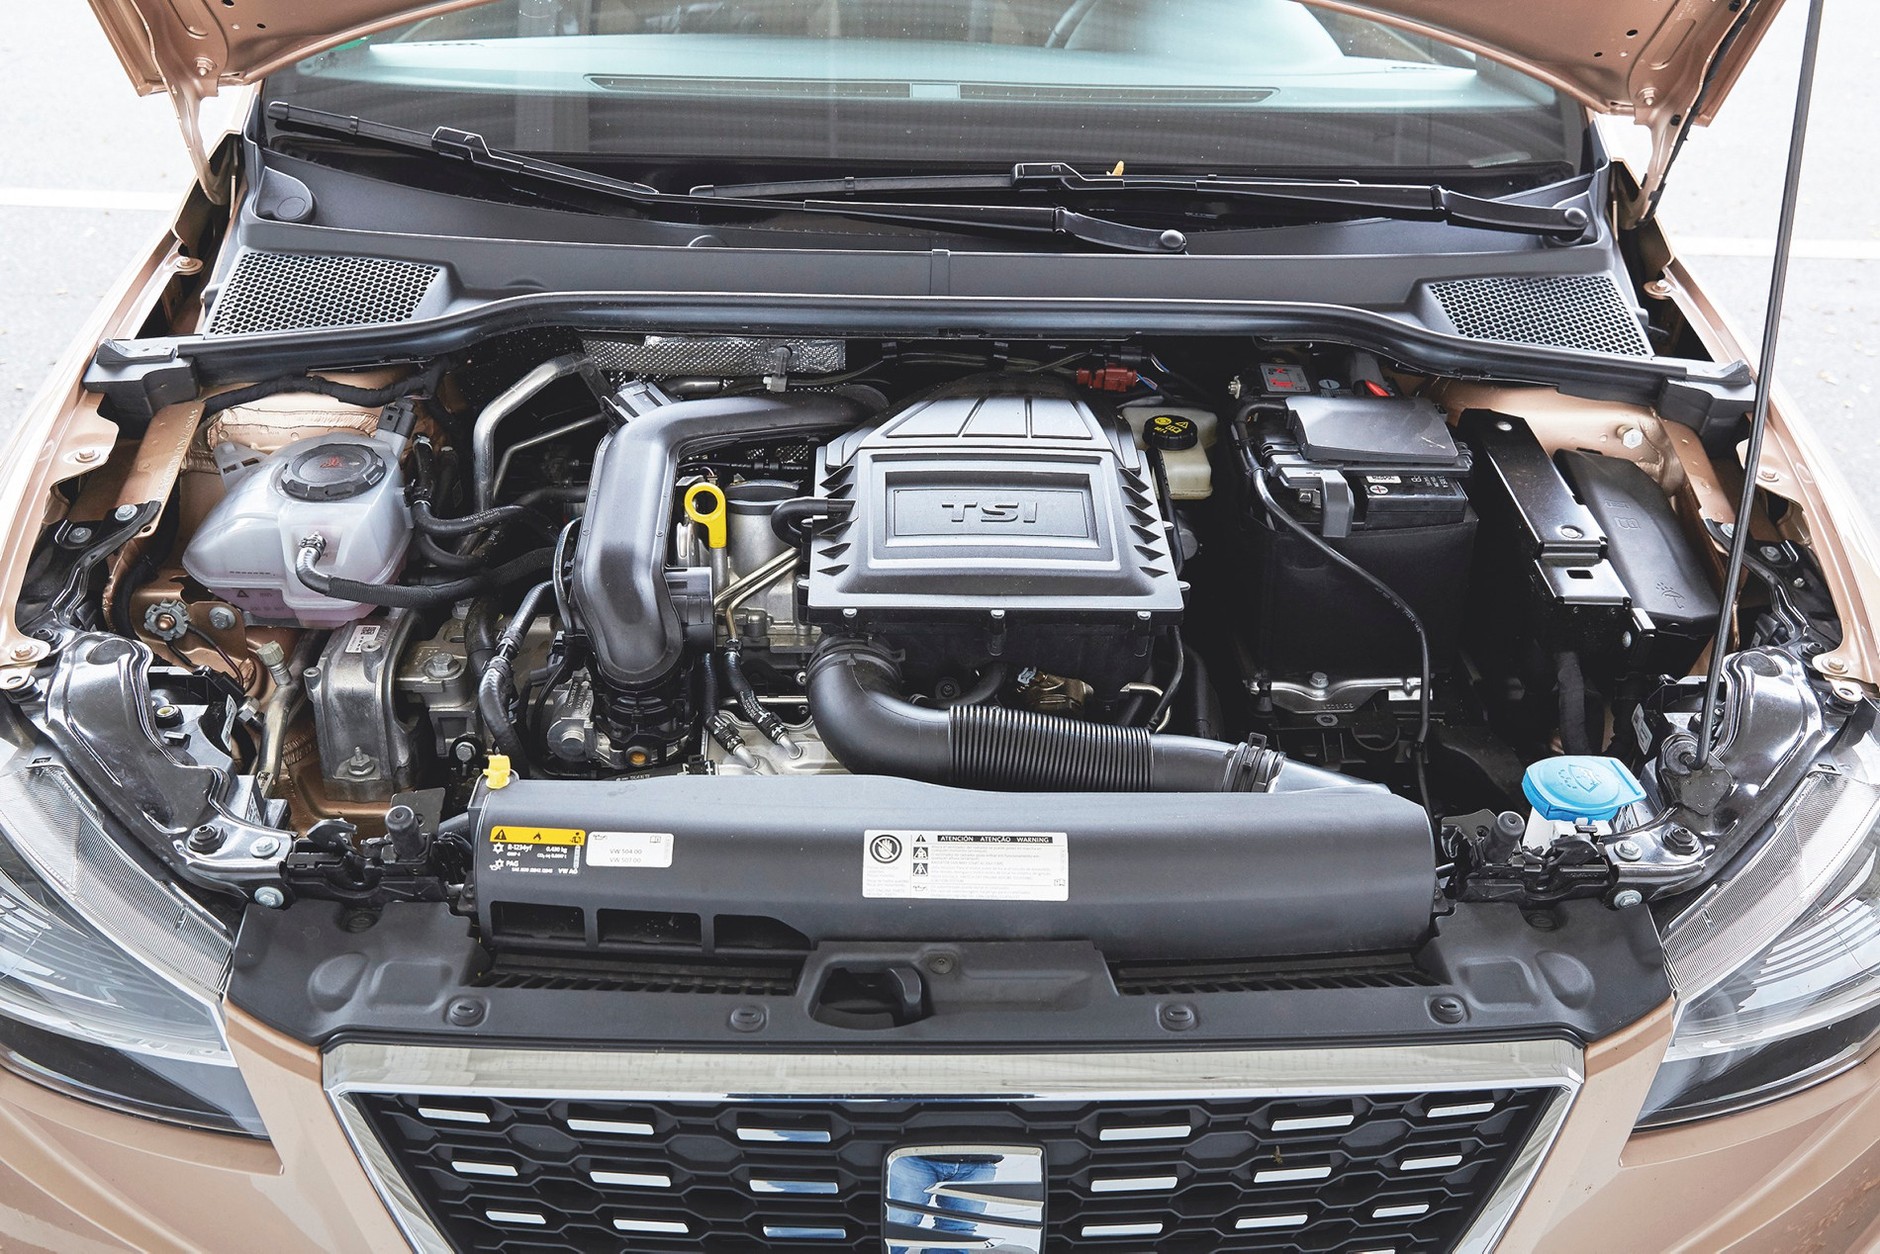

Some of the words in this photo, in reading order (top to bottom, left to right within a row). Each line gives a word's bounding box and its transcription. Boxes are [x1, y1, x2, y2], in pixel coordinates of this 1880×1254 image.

[941, 501, 1038, 524] TSI
[939, 834, 974, 842] ATENCIÓN
[980, 835, 1012, 844] ATENÇÃO
[1016, 836, 1049, 844] WARNING
